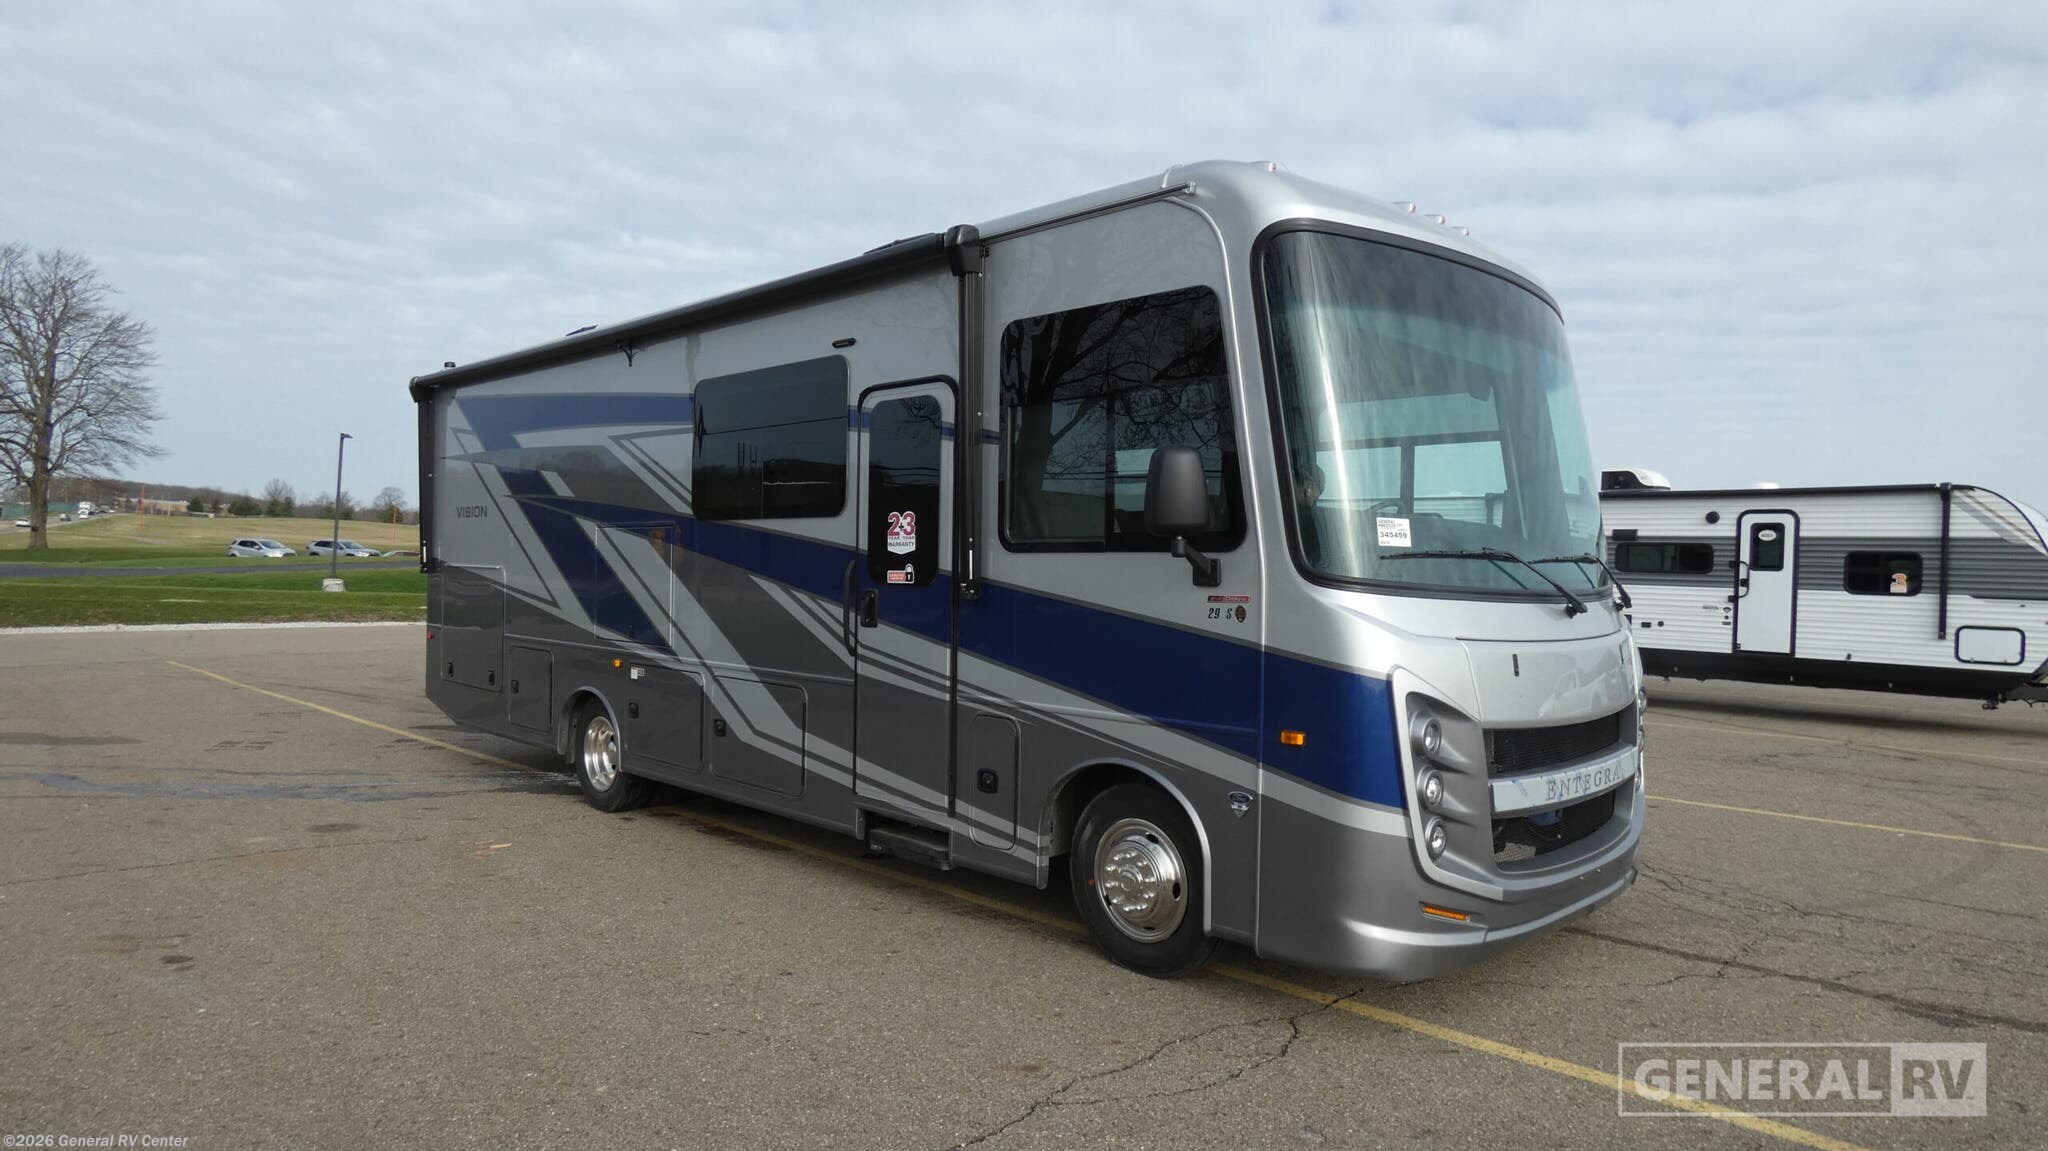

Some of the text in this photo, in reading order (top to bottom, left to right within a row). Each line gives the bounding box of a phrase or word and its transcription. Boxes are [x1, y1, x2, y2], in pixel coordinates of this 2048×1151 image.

[456, 505, 488, 519] VISION
[1379, 531, 1408, 539] 345459
[1208, 607, 1221, 619] 29
[1545, 764, 1621, 801] ENTEGRA
